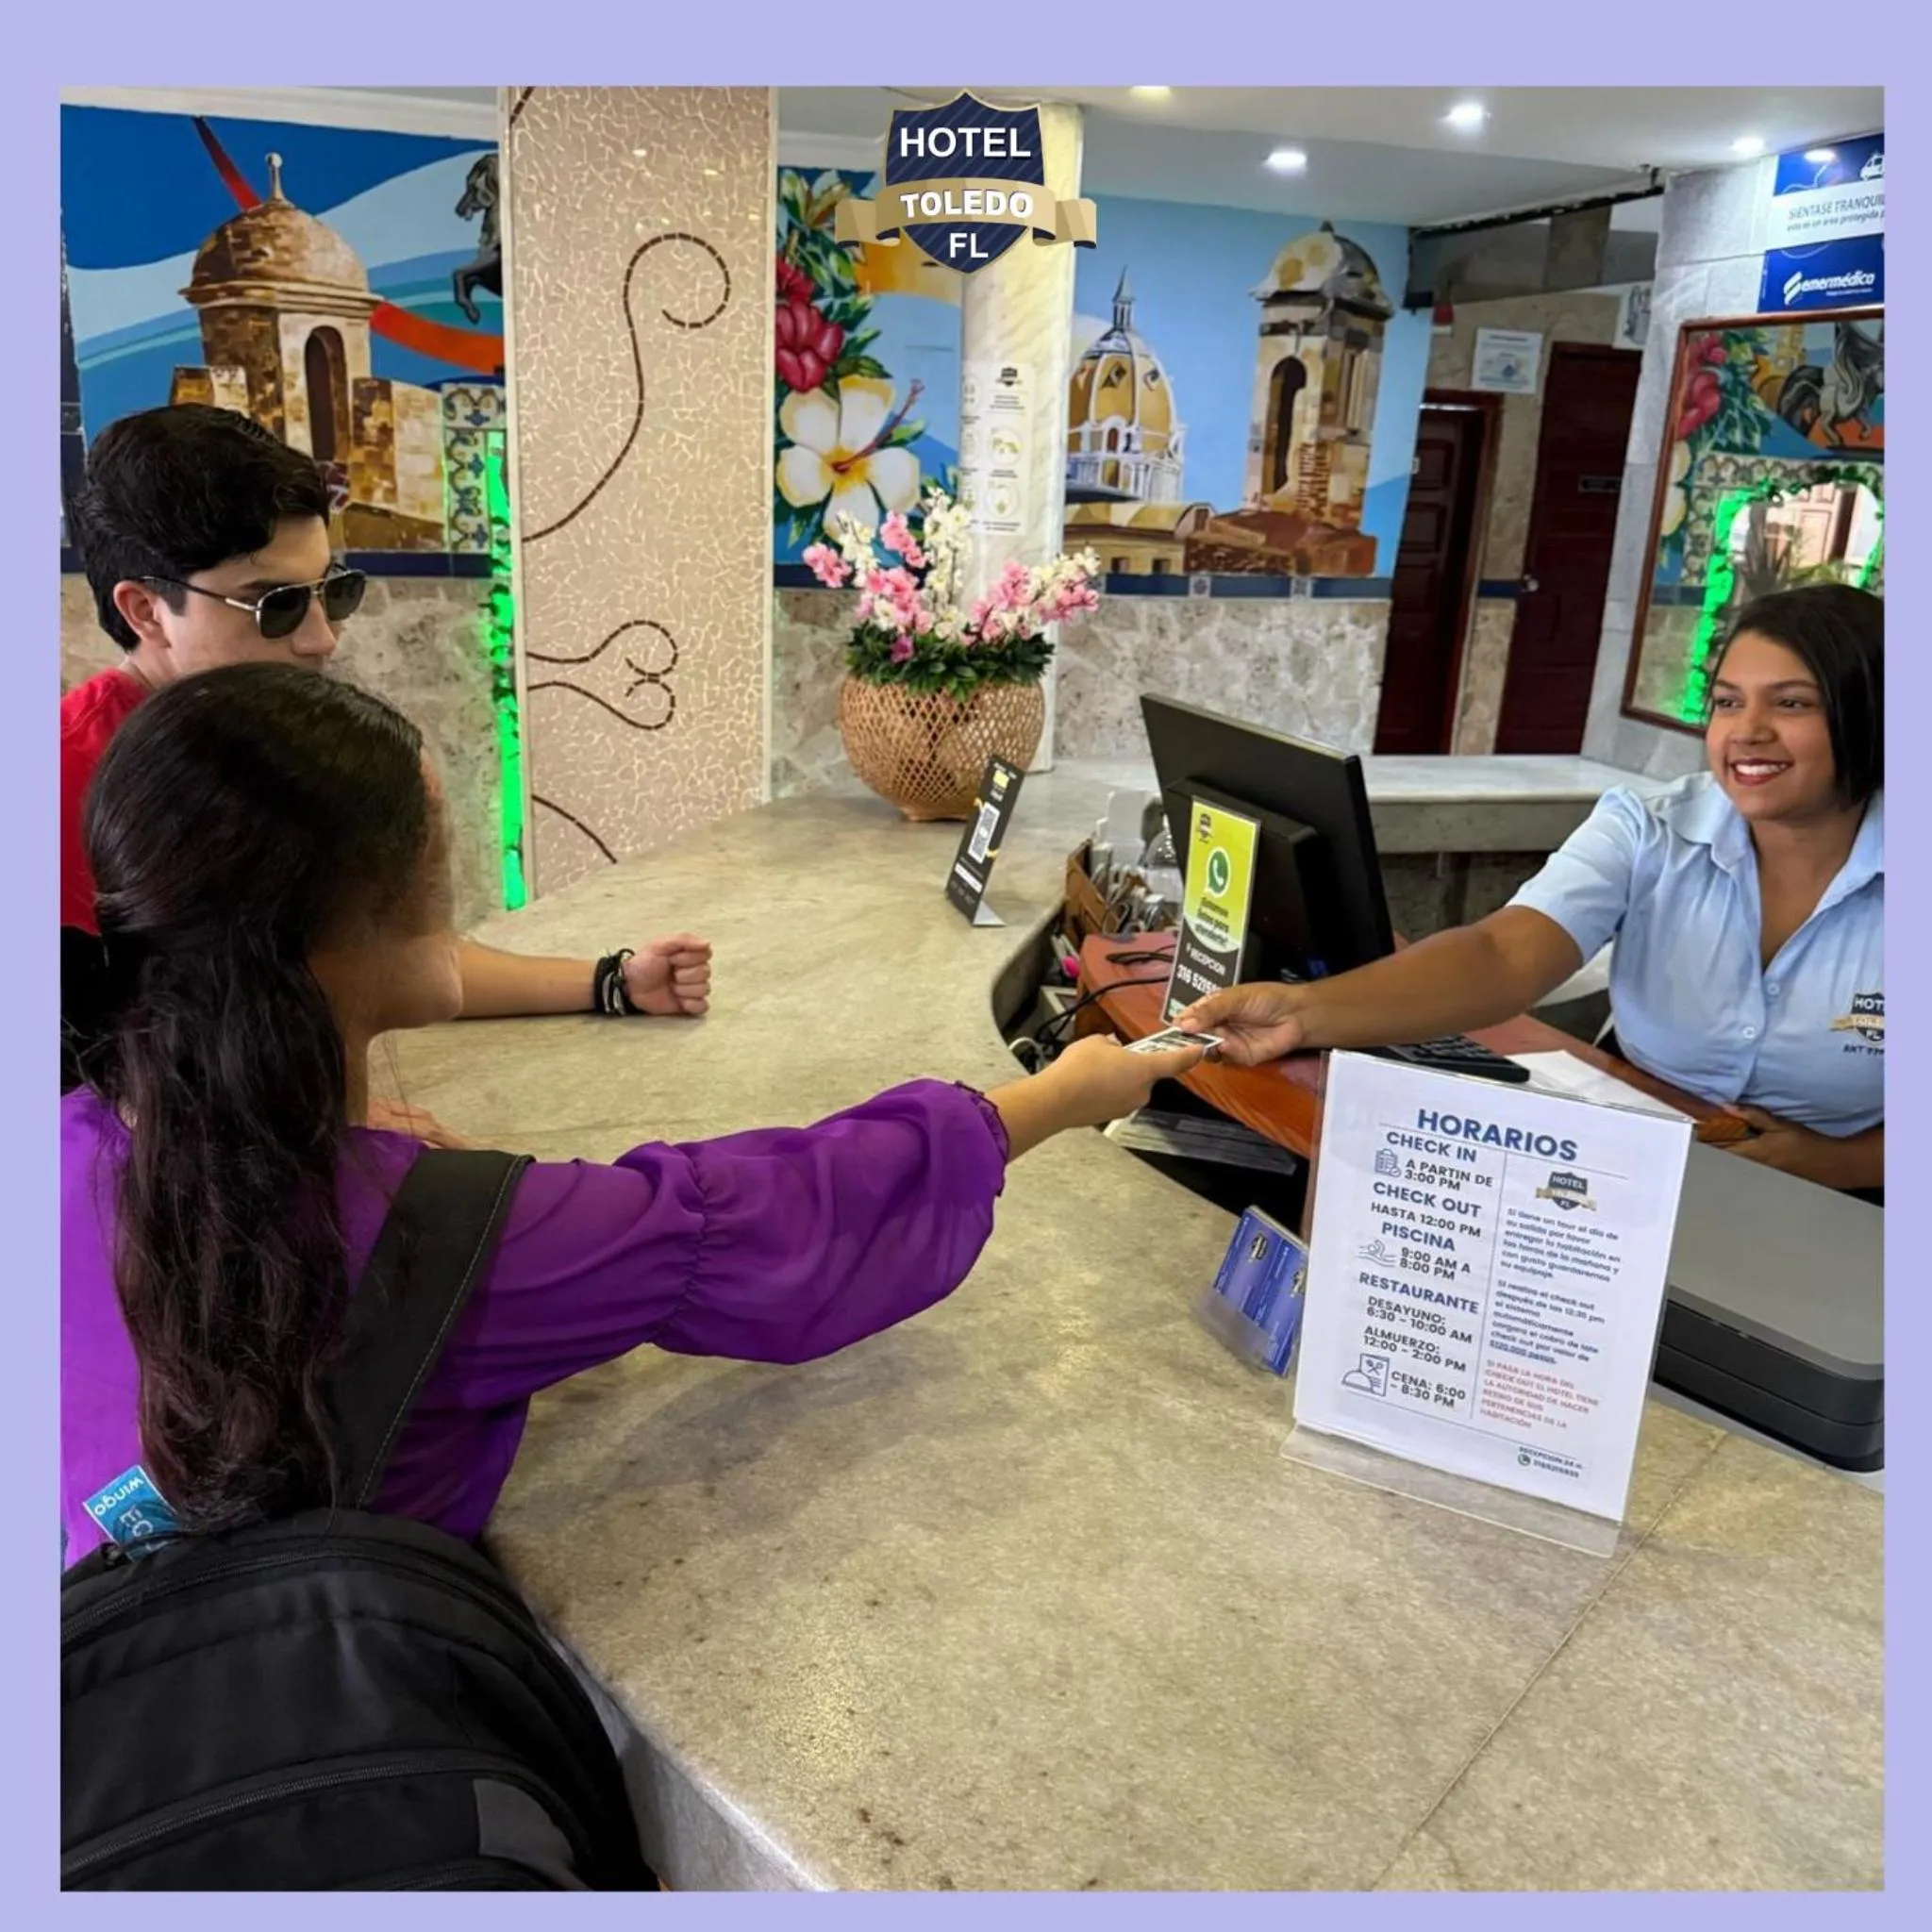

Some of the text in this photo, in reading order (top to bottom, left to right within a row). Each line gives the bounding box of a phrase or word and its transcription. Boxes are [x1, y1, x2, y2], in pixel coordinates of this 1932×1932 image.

[1386, 1131, 1477, 1163] CHECK IN
[1417, 1108, 1578, 1161] HORARIOS
[1404, 1170, 1460, 1191] 3:00 PM
[1405, 1158, 1415, 1169] A
[1474, 1174, 1493, 1188] DE
[1552, 1175, 1584, 1189] HOTEL
[1373, 1181, 1481, 1217] CHECK OUT
[1371, 1202, 1481, 1238] HASTA 12:00 PM
[1381, 1222, 1456, 1251] PISCINA
[1400, 1258, 1456, 1280] 8:00 PM
[1401, 1247, 1471, 1273] 9:00 AM A
[1359, 1272, 1479, 1314] RESTAURANTE
[1368, 1296, 1446, 1325] DESAYUNO:
[1364, 1325, 1441, 1354] ALMUERZO:
[1367, 1307, 1395, 1322] 6:30
[1410, 1319, 1447, 1336] 10:00
[1450, 1330, 1473, 1344] AM
[1364, 1336, 1397, 1352] 12:00
[1411, 1349, 1441, 1365] 2:00
[1444, 1358, 1466, 1372] PM
[1391, 1371, 1466, 1399] CENA: 6:00
[1401, 1384, 1430, 1400] 8:30
[1434, 1395, 1455, 1407] PM
[94, 1476, 145, 1516] wingo
